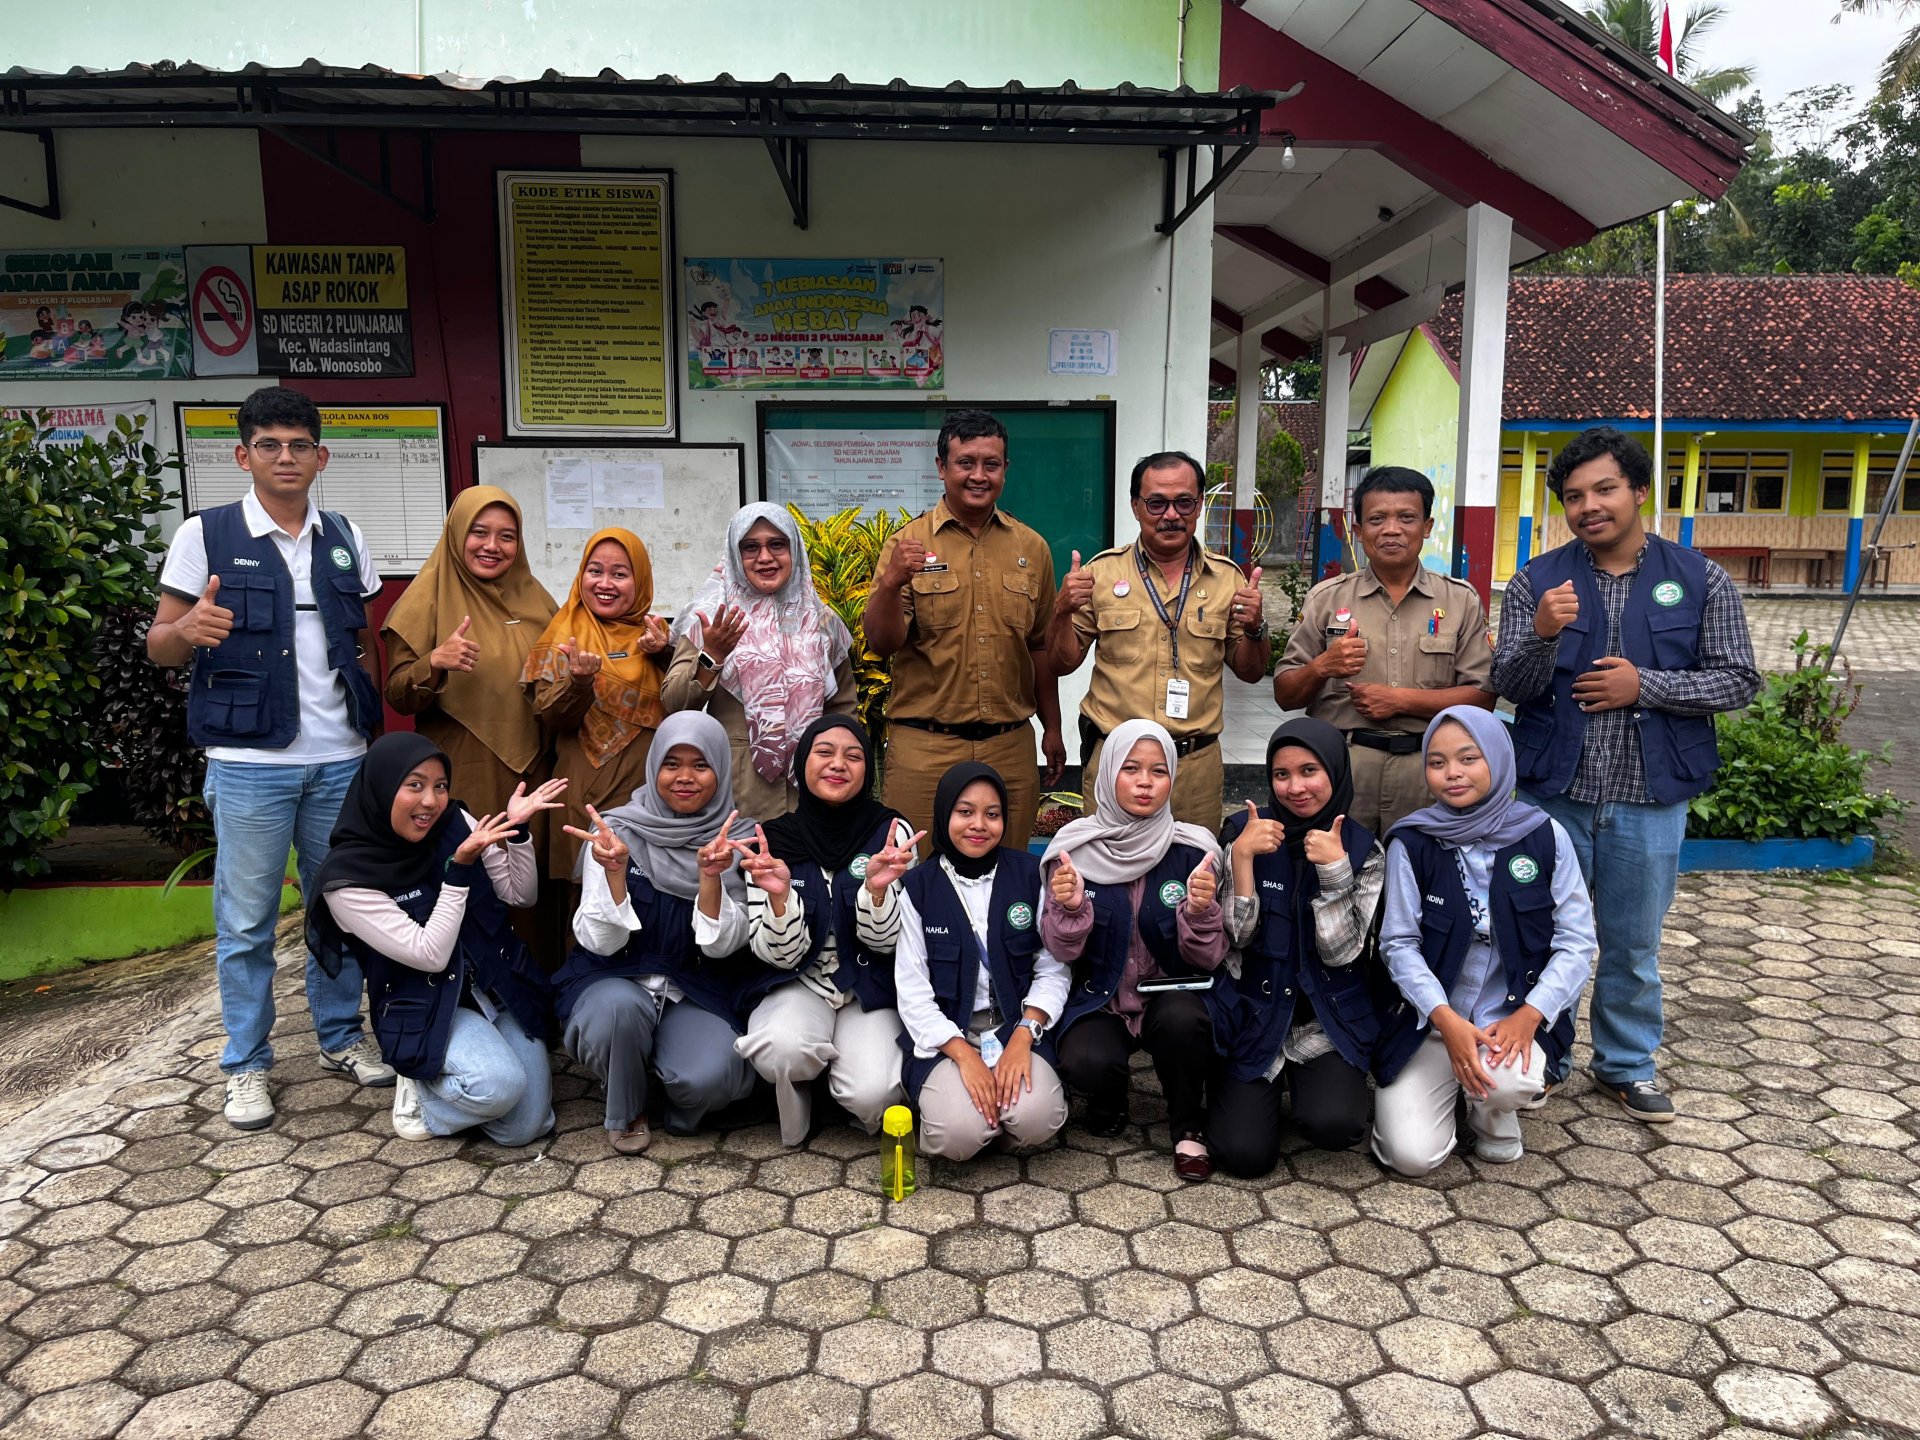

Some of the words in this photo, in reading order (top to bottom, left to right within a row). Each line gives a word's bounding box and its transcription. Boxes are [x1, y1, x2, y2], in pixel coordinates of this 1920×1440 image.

[518, 187, 558, 197] KODE
[564, 188, 600, 198] ETIK
[606, 188, 655, 199] SISWA
[5, 253, 113, 272] SEKOLAH
[266, 252, 341, 275] KAWASAN
[346, 252, 394, 274] TANPA
[0, 273, 68, 291] AMAH
[72, 272, 140, 290] ANAK
[776, 274, 877, 294] KEBIASAAN
[281, 281, 321, 303] ASAP
[325, 281, 379, 303] ROKOK
[754, 297, 794, 317] ANAK
[796, 294, 889, 316] INDONESIA
[61, 323, 69, 334] B
[262, 314, 277, 334] SD
[280, 314, 323, 334] NEGERI
[326, 314, 334, 333] 2
[336, 314, 402, 333] PLUNJARAN
[772, 310, 863, 333] HEBAT
[57, 340, 66, 351] A
[279, 338, 306, 354] Kec.
[309, 337, 390, 356] Wadaslintang
[289, 358, 317, 373] Kab.
[321, 358, 382, 374] Wonosobo
[41, 408, 106, 427] ERSAMA
[234, 558, 260, 567] DENNY
[1084, 890, 1096, 898] SRI
[1262, 880, 1284, 891] SHASI
[925, 926, 949, 934] NAHLA
